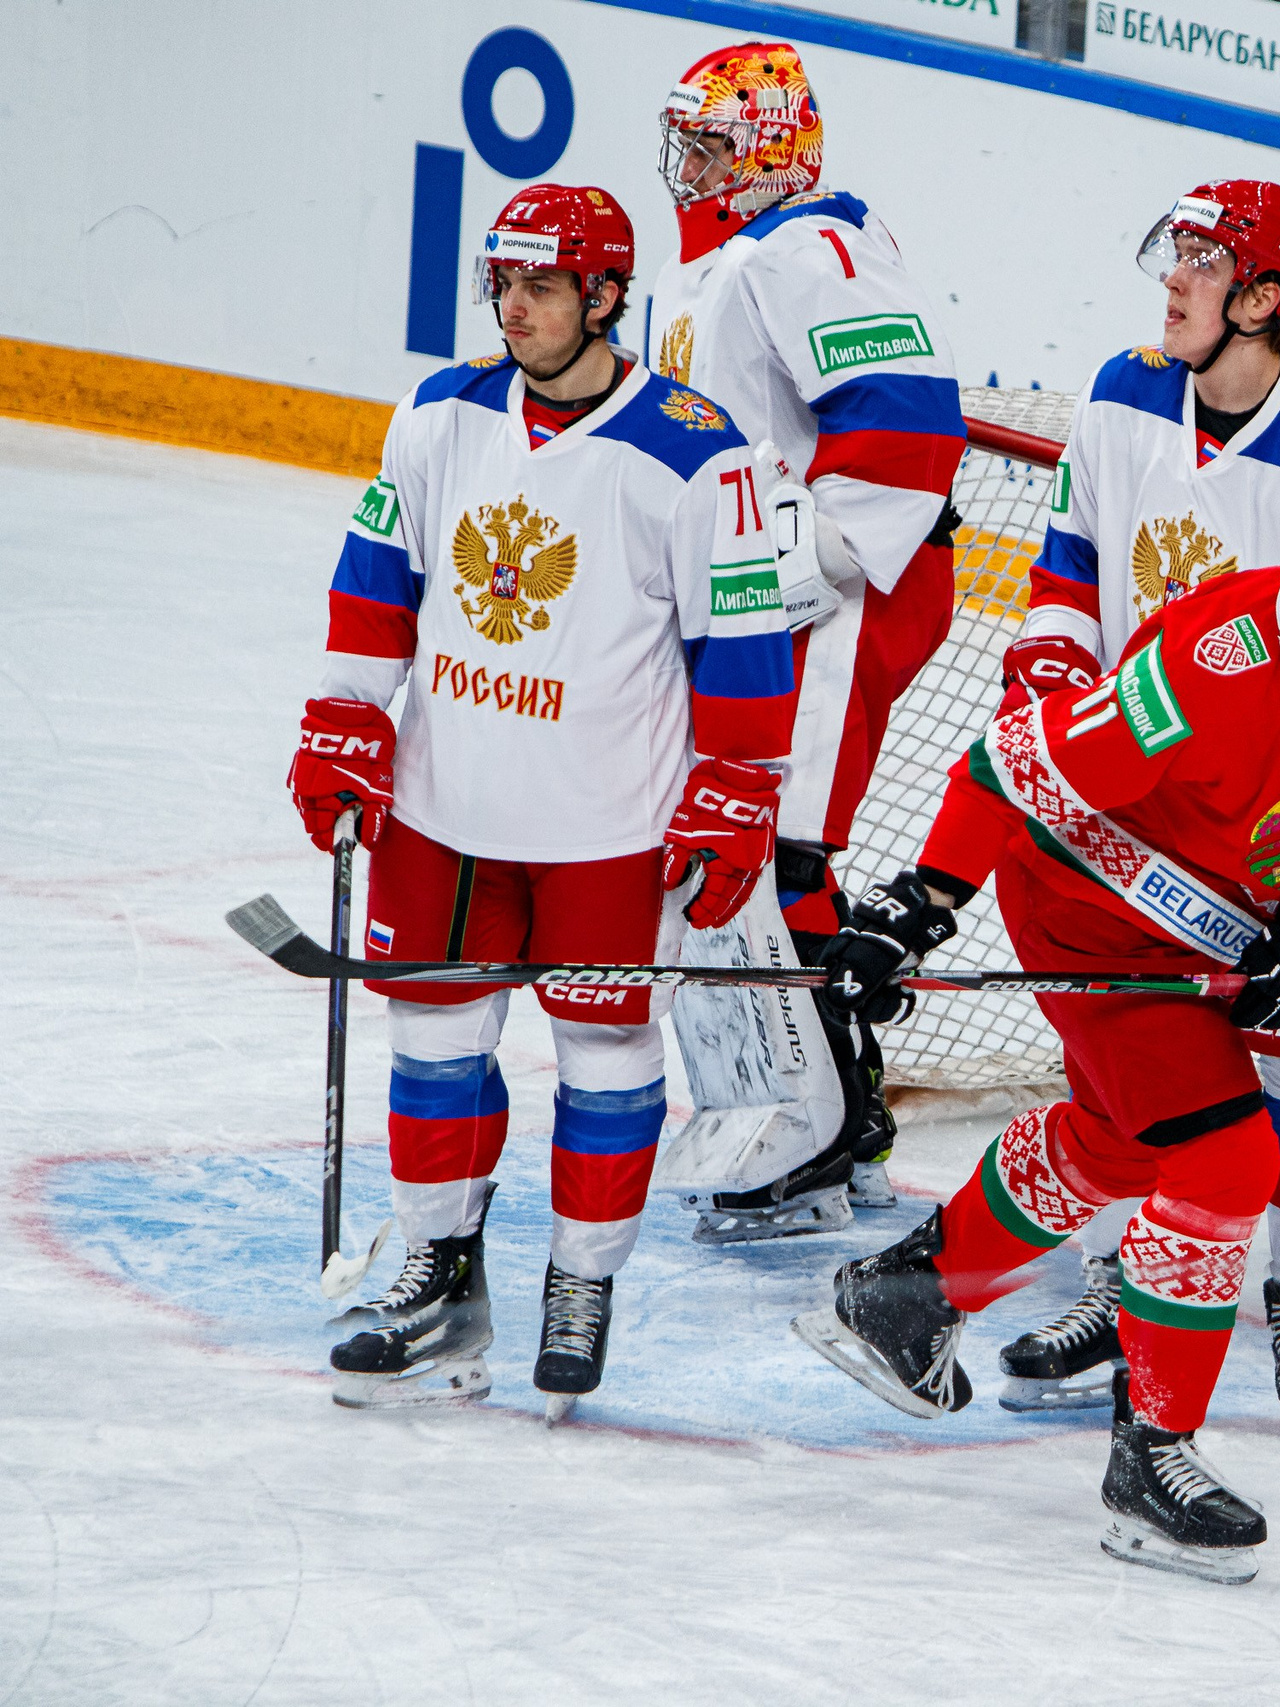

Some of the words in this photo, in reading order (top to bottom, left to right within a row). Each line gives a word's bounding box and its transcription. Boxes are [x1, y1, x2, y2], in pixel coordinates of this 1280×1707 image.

[502, 238, 555, 252] НОРНИКЕЛЬ
[603, 242, 630, 252] CCM
[719, 465, 764, 537] 71
[746, 586, 781, 608] СТАВО
[1238, 619, 1262, 661] БЕЛАРУСЬ
[432, 653, 565, 722] РОССИЯ
[694, 786, 776, 828] CCM
[1140, 870, 1256, 954] BELARUS
[545, 983, 628, 1006] CCM
